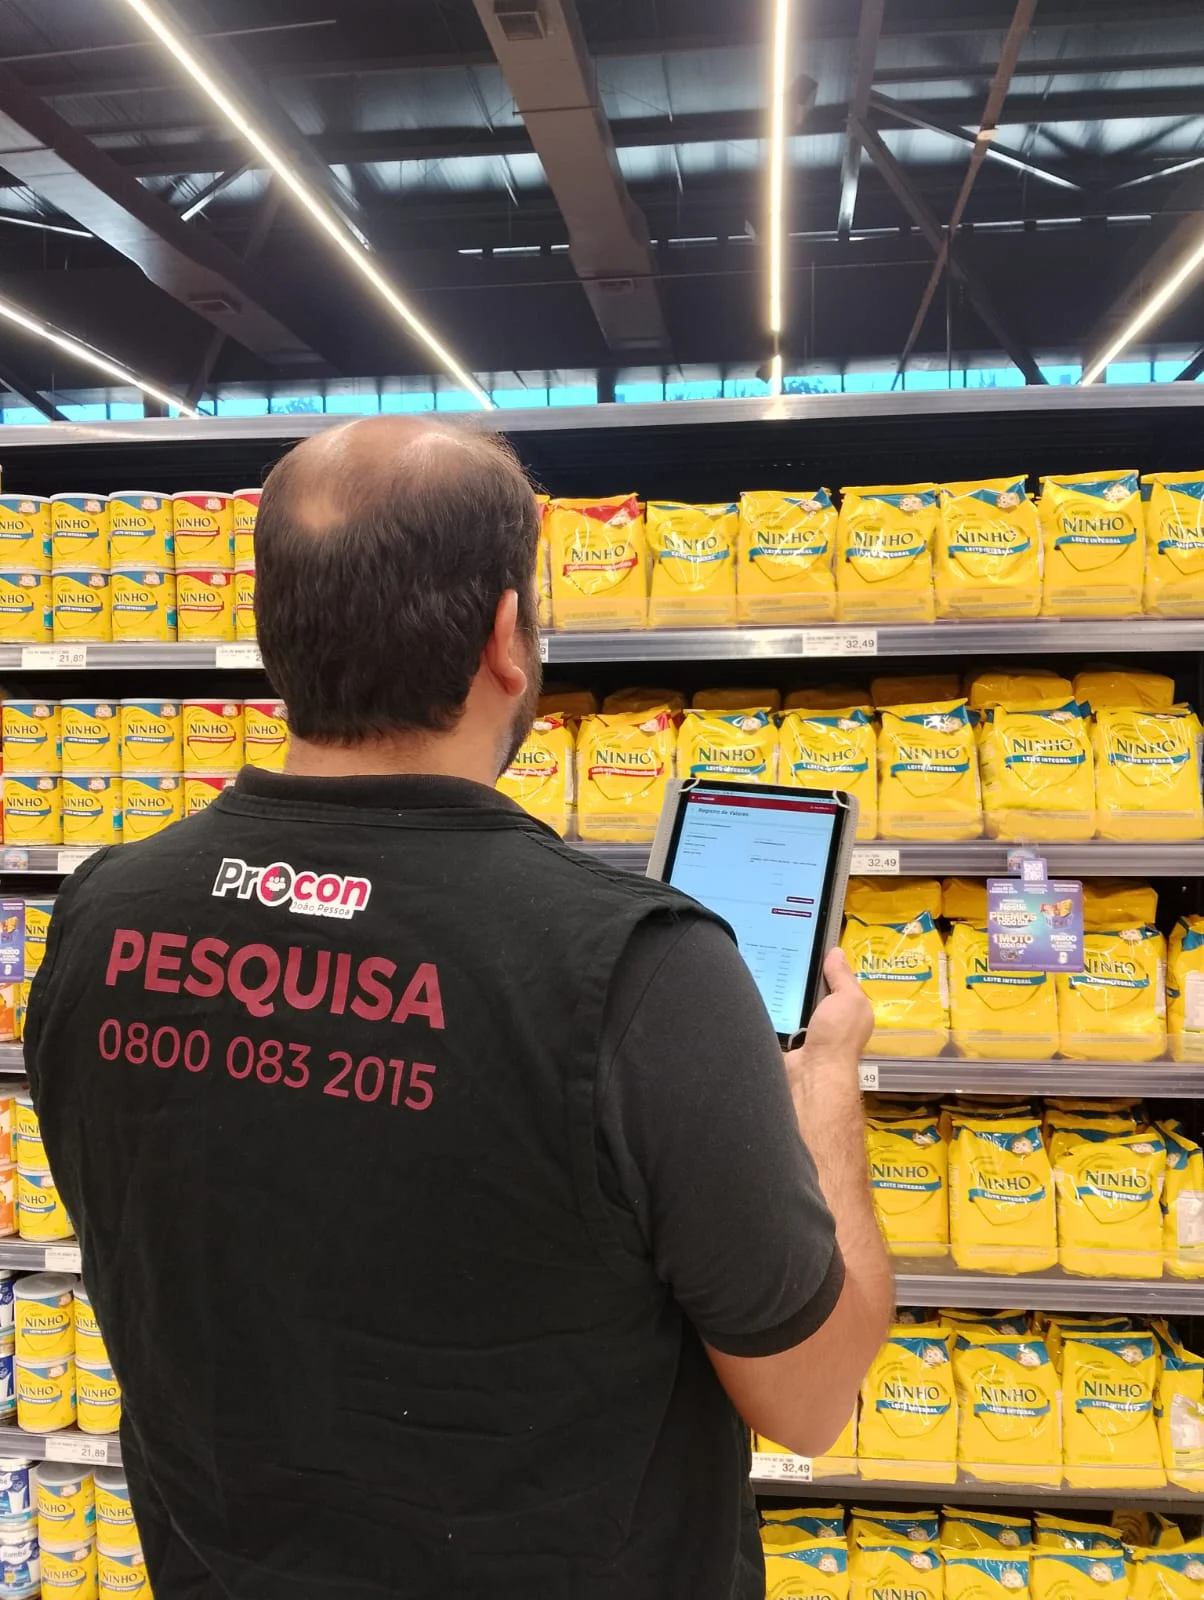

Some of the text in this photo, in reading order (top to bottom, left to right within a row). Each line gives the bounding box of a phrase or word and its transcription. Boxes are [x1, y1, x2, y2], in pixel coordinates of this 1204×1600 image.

[55, 519, 90, 529] NINHO
[113, 517, 146, 527] NINHO
[177, 517, 211, 528] NINHO
[1063, 517, 1124, 533] NINHO
[757, 530, 816, 545] NINHO
[854, 531, 914, 547] NINHO
[956, 529, 1016, 544] NINHO
[572, 545, 626, 562] NINHO
[57, 593, 94, 604] NINHO
[114, 592, 149, 602] NINHO
[180, 592, 216, 602] NINHO
[5, 724, 39, 734] NINHO
[66, 724, 101, 735] NINHO
[128, 723, 166, 734] NINHO
[190, 723, 228, 734] NINHO
[247, 724, 278, 735] NINHO
[1013, 738, 1073, 752] NINHO
[1117, 738, 1176, 754] NINHO
[596, 750, 651, 765] NINHO
[700, 747, 756, 762] NINHO
[800, 746, 857, 763] NINHO
[900, 746, 960, 761] NINHO
[7, 796, 42, 807] NINHO
[128, 796, 165, 807] NINHO
[292, 901, 350, 916] João Pessoa
[1000, 934, 1034, 944] MOTO
[861, 955, 919, 970] NINHO
[1084, 957, 1136, 975] NINHO
[104, 928, 446, 1030] PESQUISA
[98, 1018, 437, 1111] 0800 083 2015
[863, 1073, 876, 1083] 49
[872, 1163, 929, 1178] NINHO
[978, 1171, 1031, 1190] NINHO
[1086, 1170, 1147, 1189] NINHO
[25, 1315, 64, 1328] NINHO
[20, 1384, 54, 1396] NINHO
[81, 1386, 117, 1398] NINHO
[884, 1381, 940, 1400] NINHO
[981, 1385, 1037, 1403] NINHO
[1083, 1381, 1142, 1398] NINHO
[81, 1448, 105, 1458] 21,89
[782, 1463, 810, 1474] 32,49
[43, 1568, 79, 1579] NINHO
[103, 1573, 138, 1584] NINHO
[872, 1588, 927, 1600] NINHO
